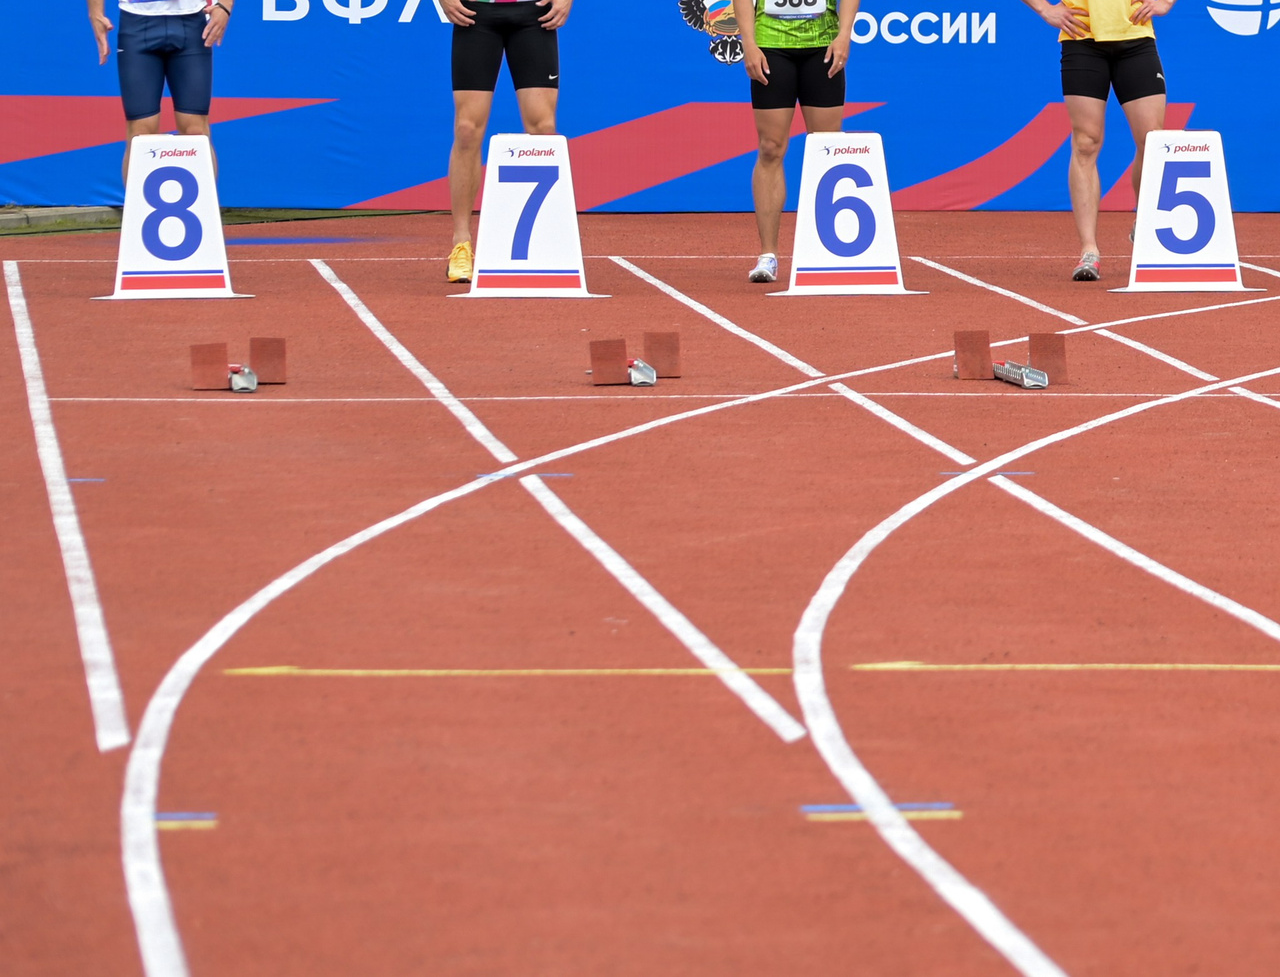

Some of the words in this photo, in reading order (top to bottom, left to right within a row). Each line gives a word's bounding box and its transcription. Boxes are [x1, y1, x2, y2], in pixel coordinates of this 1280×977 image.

[849, 11, 996, 44] ОССИИ
[160, 148, 198, 159] polanik
[518, 147, 556, 158] polanik
[833, 146, 871, 156] polanik
[1173, 144, 1210, 154] polanik
[141, 165, 204, 262] 8
[498, 165, 560, 261] 7
[814, 163, 877, 258] 6
[1155, 160, 1216, 255] 5
